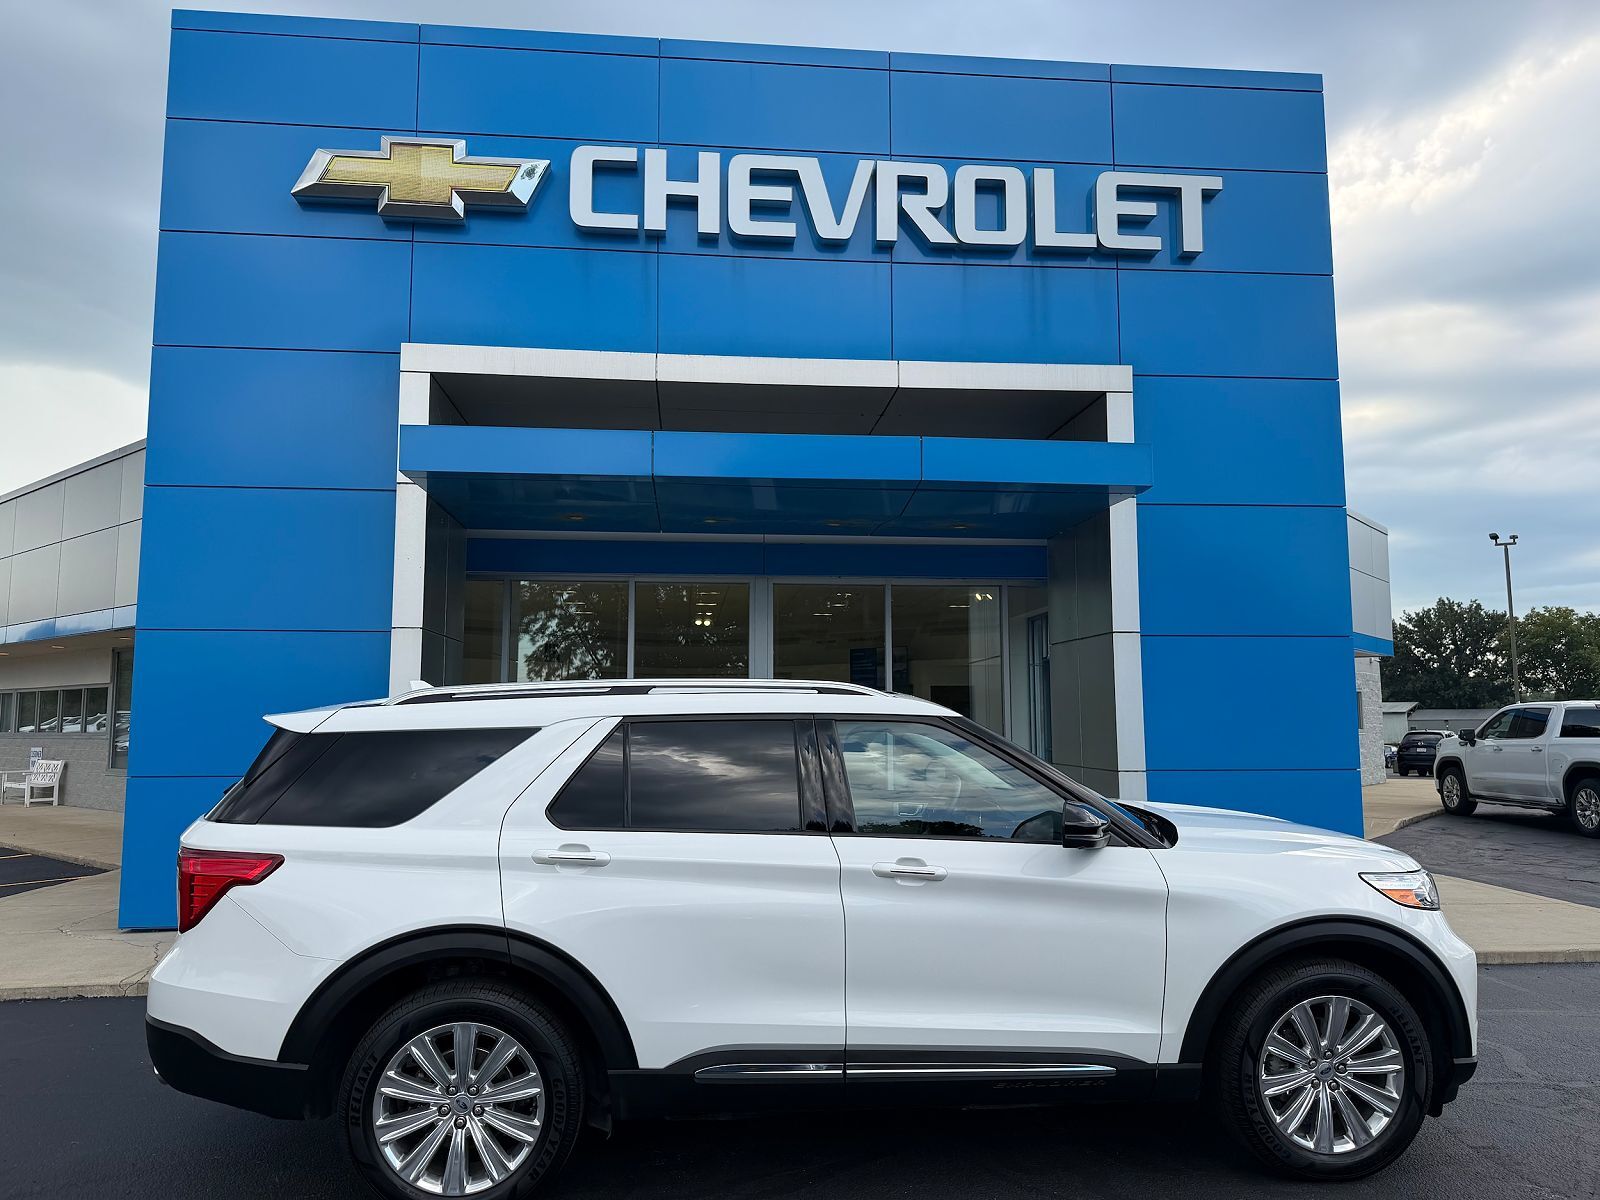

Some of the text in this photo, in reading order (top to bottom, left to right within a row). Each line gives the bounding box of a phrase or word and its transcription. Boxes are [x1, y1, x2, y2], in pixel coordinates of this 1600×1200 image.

[569, 144, 1223, 255] CHEVROLET
[1389, 1005, 1425, 1066] RELIANT
[348, 1055, 378, 1127] RELIANT
